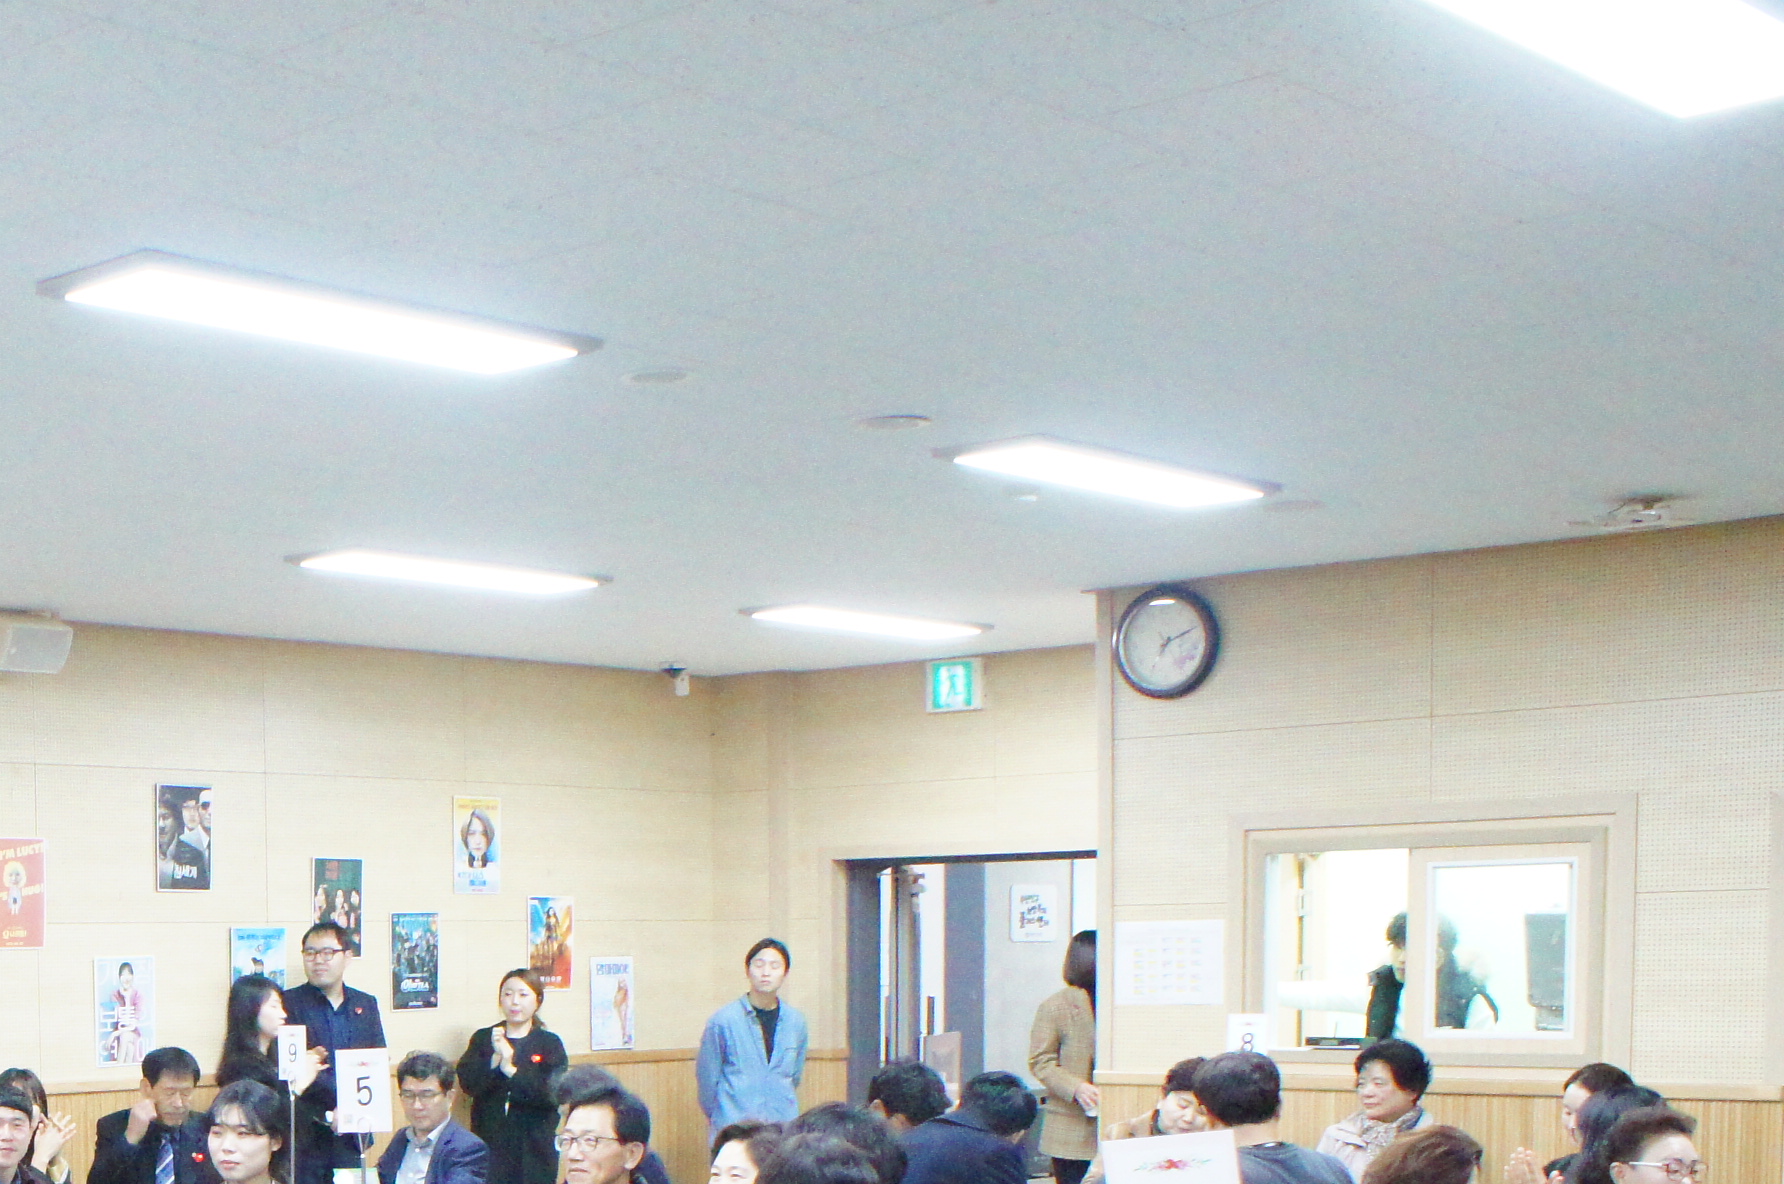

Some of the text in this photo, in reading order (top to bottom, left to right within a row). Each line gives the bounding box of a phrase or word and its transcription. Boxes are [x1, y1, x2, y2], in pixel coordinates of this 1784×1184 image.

[1241, 1033, 1254, 1052] 8
[288, 1043, 297, 1063] 9
[356, 1076, 373, 1106] 5
